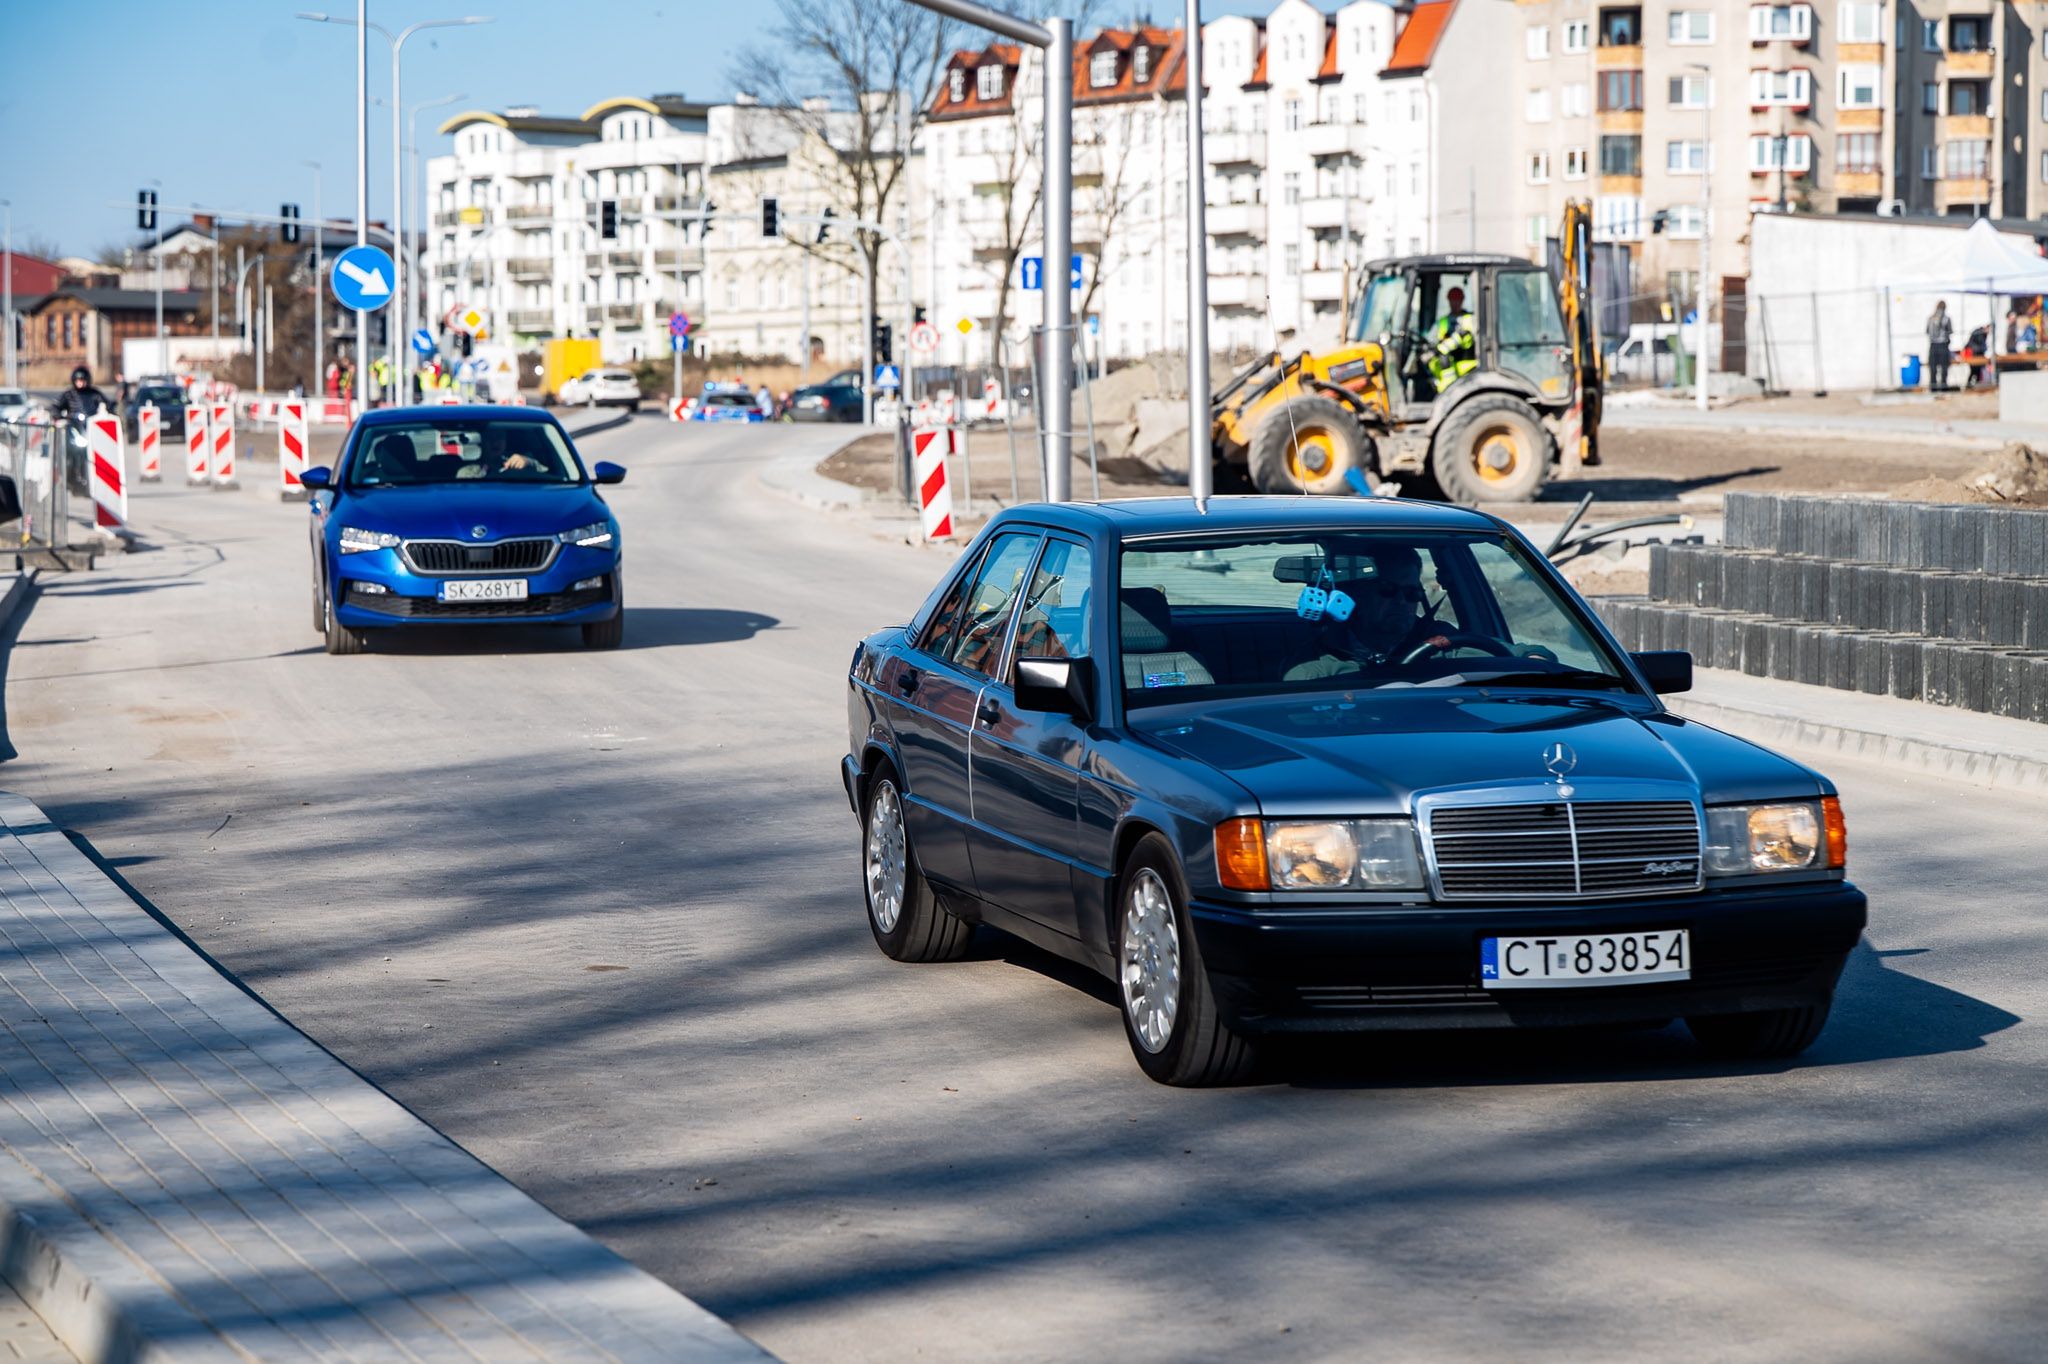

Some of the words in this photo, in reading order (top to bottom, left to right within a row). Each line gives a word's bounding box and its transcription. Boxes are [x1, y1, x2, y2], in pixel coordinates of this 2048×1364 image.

[448, 583, 468, 599] SK
[475, 582, 523, 598] 268YT
[1505, 939, 1558, 977] CT
[1574, 932, 1684, 975] 83854
[1482, 964, 1497, 975] PL
